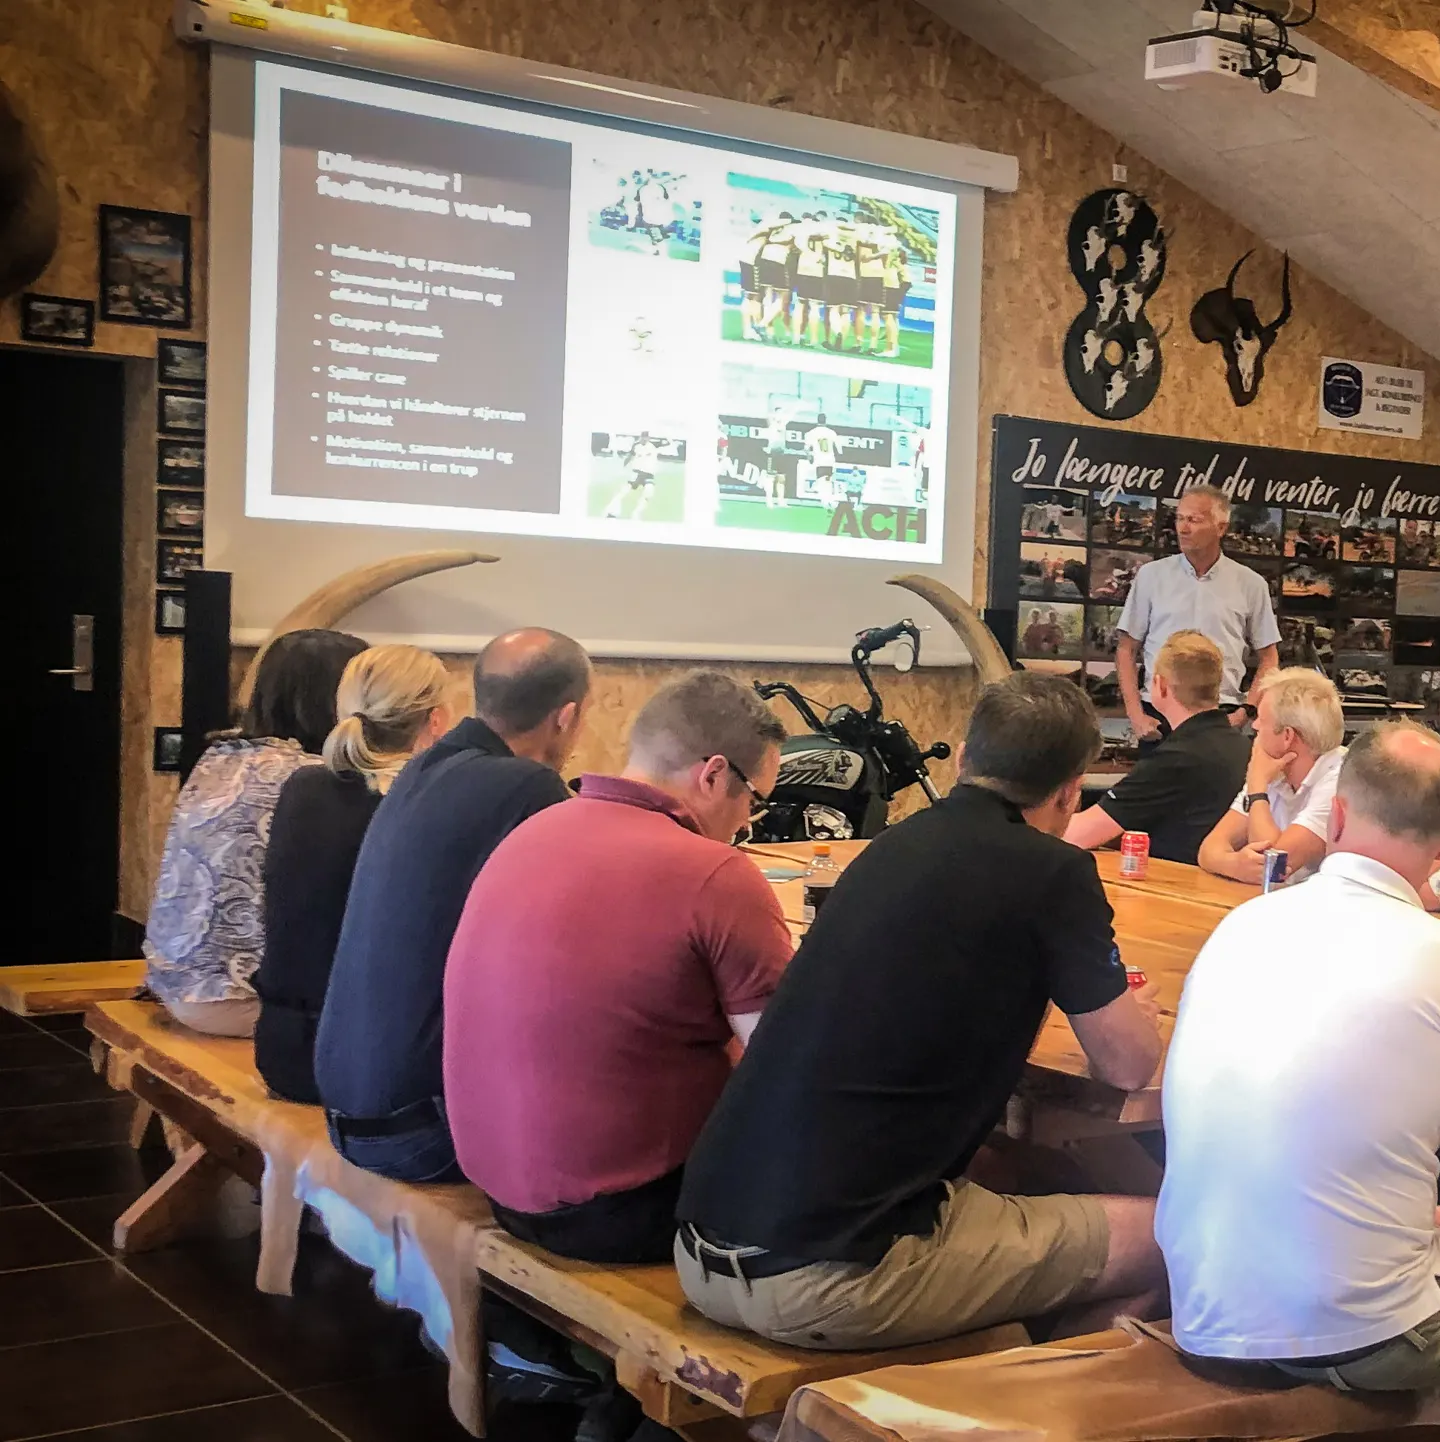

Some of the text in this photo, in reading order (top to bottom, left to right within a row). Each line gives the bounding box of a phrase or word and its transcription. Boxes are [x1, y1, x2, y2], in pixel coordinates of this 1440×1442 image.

[454, 201, 531, 227] verden
[331, 244, 406, 268] Indledning
[407, 257, 426, 271] og
[330, 269, 503, 307] Sammenhold i et team og
[329, 313, 444, 338] Gruppe dynamik
[327, 391, 387, 408] Hvordan
[389, 398, 402, 410] vi
[327, 408, 394, 426] på holdet
[408, 444, 495, 460] sammenhold
[496, 451, 513, 464] og
[422, 460, 427, 471] i
[449, 463, 478, 477] trup
[1012, 438, 1047, 483] Jo
[1054, 437, 1164, 507] længere
[1174, 454, 1220, 497] tid
[1222, 457, 1256, 501] du
[1265, 475, 1340, 513] venter,
[1341, 482, 1375, 528] jo
[1381, 475, 1440, 518] færre
